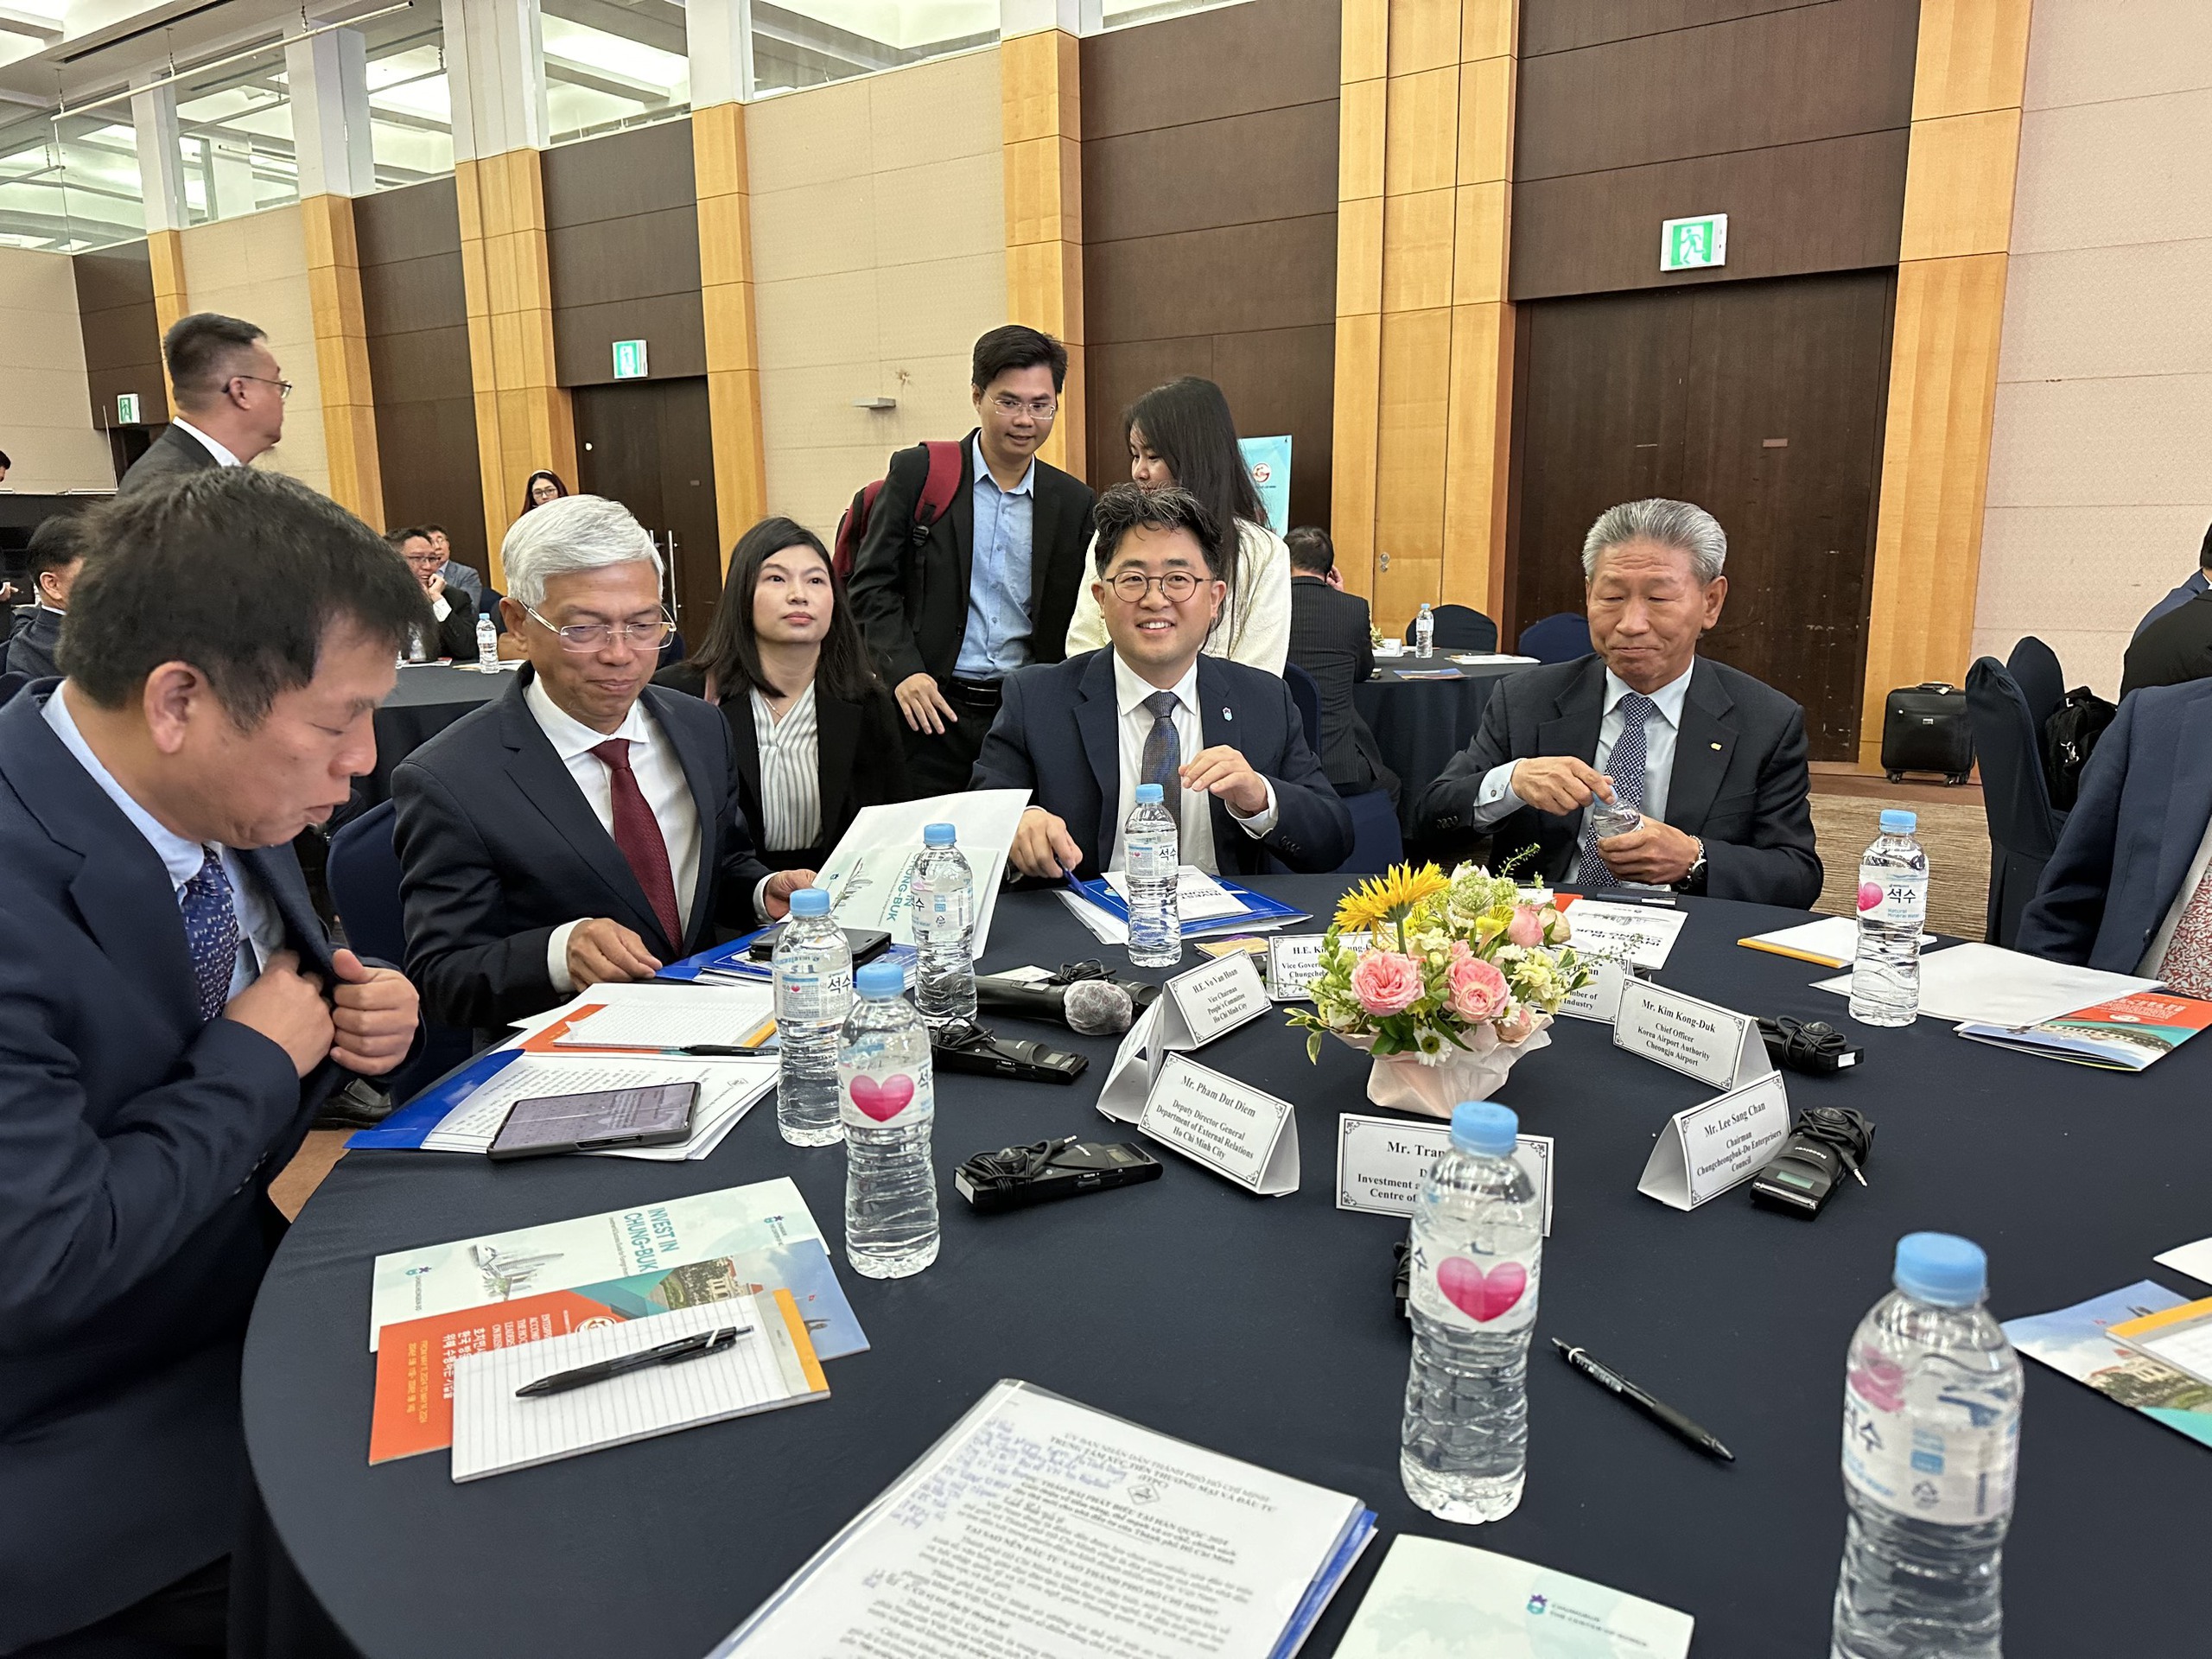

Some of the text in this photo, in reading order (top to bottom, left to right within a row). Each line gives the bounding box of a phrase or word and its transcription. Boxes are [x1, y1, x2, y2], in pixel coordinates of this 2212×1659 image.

[1159, 847, 1177, 861] 석수
[1887, 888, 1916, 904] 석수
[828, 974, 851, 994] 석수
[1217, 987, 1237, 1000] Chairman
[1564, 998, 1593, 1010] Industry
[1642, 999, 1716, 1033] Mr. Kim Kong-Duk
[1656, 1022, 1694, 1043] Chief Officer
[1637, 1026, 1711, 1061] Korea Airport Authority
[1646, 1040, 1699, 1066] Cheongju Airport
[1181, 1075, 1256, 1117] Mr. Pham Dut Diem
[1172, 1099, 1246, 1141] Deputy Director General
[1704, 1103, 1766, 1138] Mr. Lee Sang Chan
[1156, 1104, 1190, 1128] Department
[1198, 1126, 1224, 1145] External
[1225, 1139, 1254, 1160] Relations
[1726, 1132, 1752, 1148] Chairman
[1173, 1126, 1227, 1160] Ho Chi Minh City
[1387, 1141, 1410, 1154] Mr.
[1697, 1129, 1782, 1176] Chungcheongbuk-Do Enterprisers
[1732, 1155, 1751, 1172] Council
[1357, 1173, 1414, 1190] Investment
[1370, 1189, 1417, 1203] Centre of
[647, 1207, 680, 1253] INVEST IN
[624, 1212, 658, 1273] CHUNG-BUK
[442, 1333, 456, 1348] 위해
[458, 1330, 472, 1345] 한국
[504, 1321, 515, 1346] LEADERS
